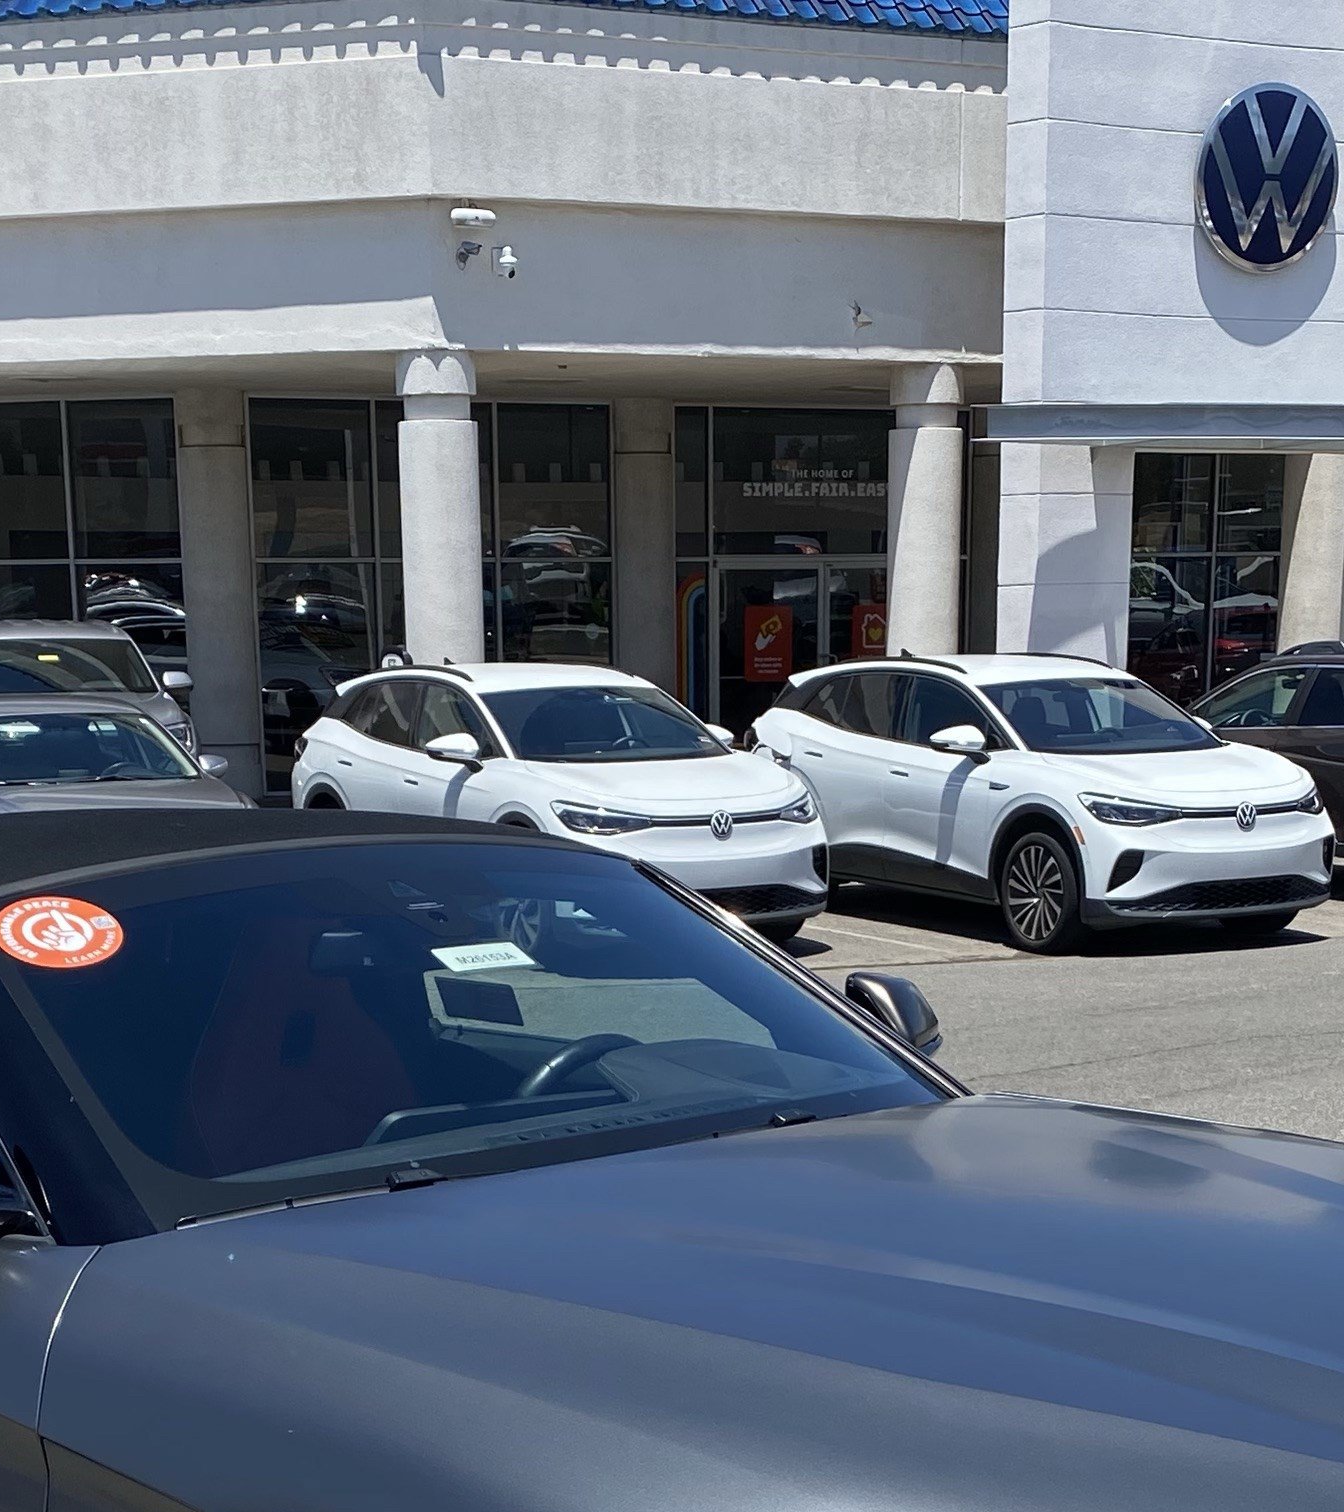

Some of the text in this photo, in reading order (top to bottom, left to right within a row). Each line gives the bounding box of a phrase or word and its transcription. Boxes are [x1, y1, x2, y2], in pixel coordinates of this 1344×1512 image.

[1199, 84, 1337, 265] VW
[792, 470, 855, 478] THE HOME OF
[742, 482, 887, 497] SIMPLE.FAIR.EAS
[23, 900, 70, 911] PEACE
[64, 930, 116, 964] LEARN MORE
